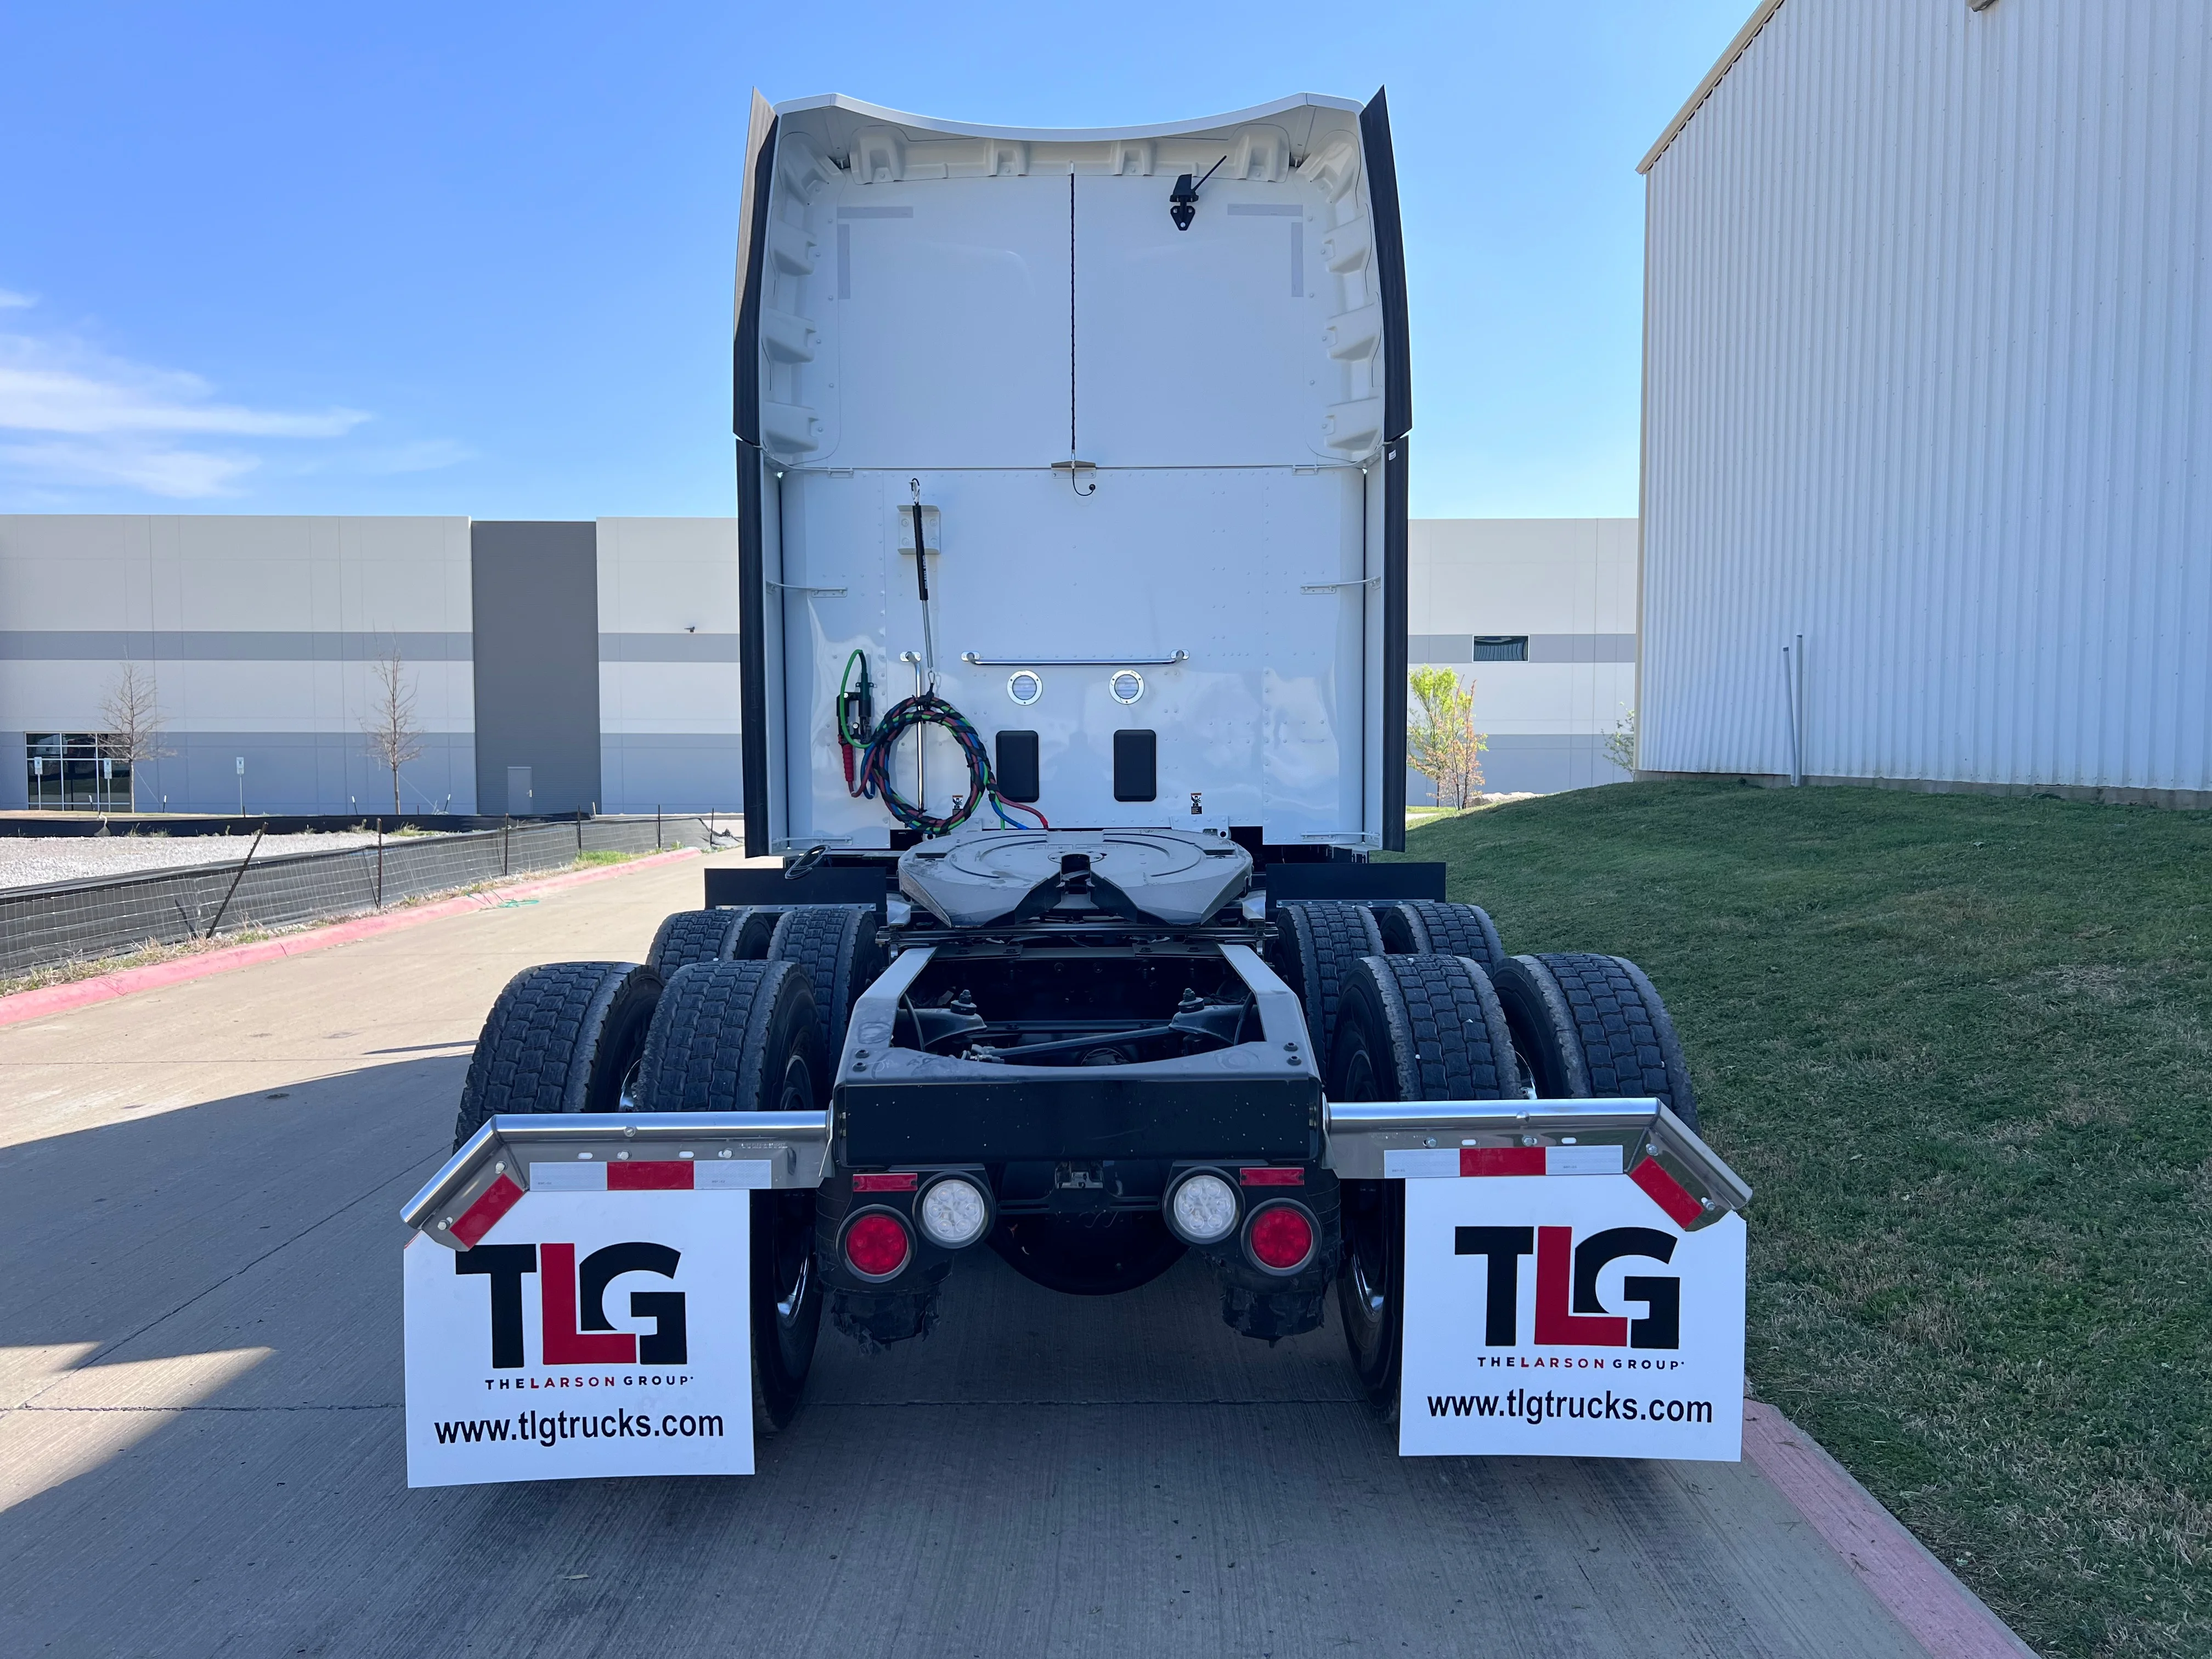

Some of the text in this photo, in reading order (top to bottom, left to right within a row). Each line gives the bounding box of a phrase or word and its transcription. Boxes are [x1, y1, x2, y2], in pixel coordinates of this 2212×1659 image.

[455, 1242, 687, 1369] TLG
[1454, 1226, 1680, 1350] TLG
[623, 1375, 689, 1386] GROUP
[1612, 1359, 1679, 1370] GROUP
[1427, 1388, 1712, 1425] www.tlgtrucks.com
[434, 1408, 724, 1447] www.tlgtrucks.com
